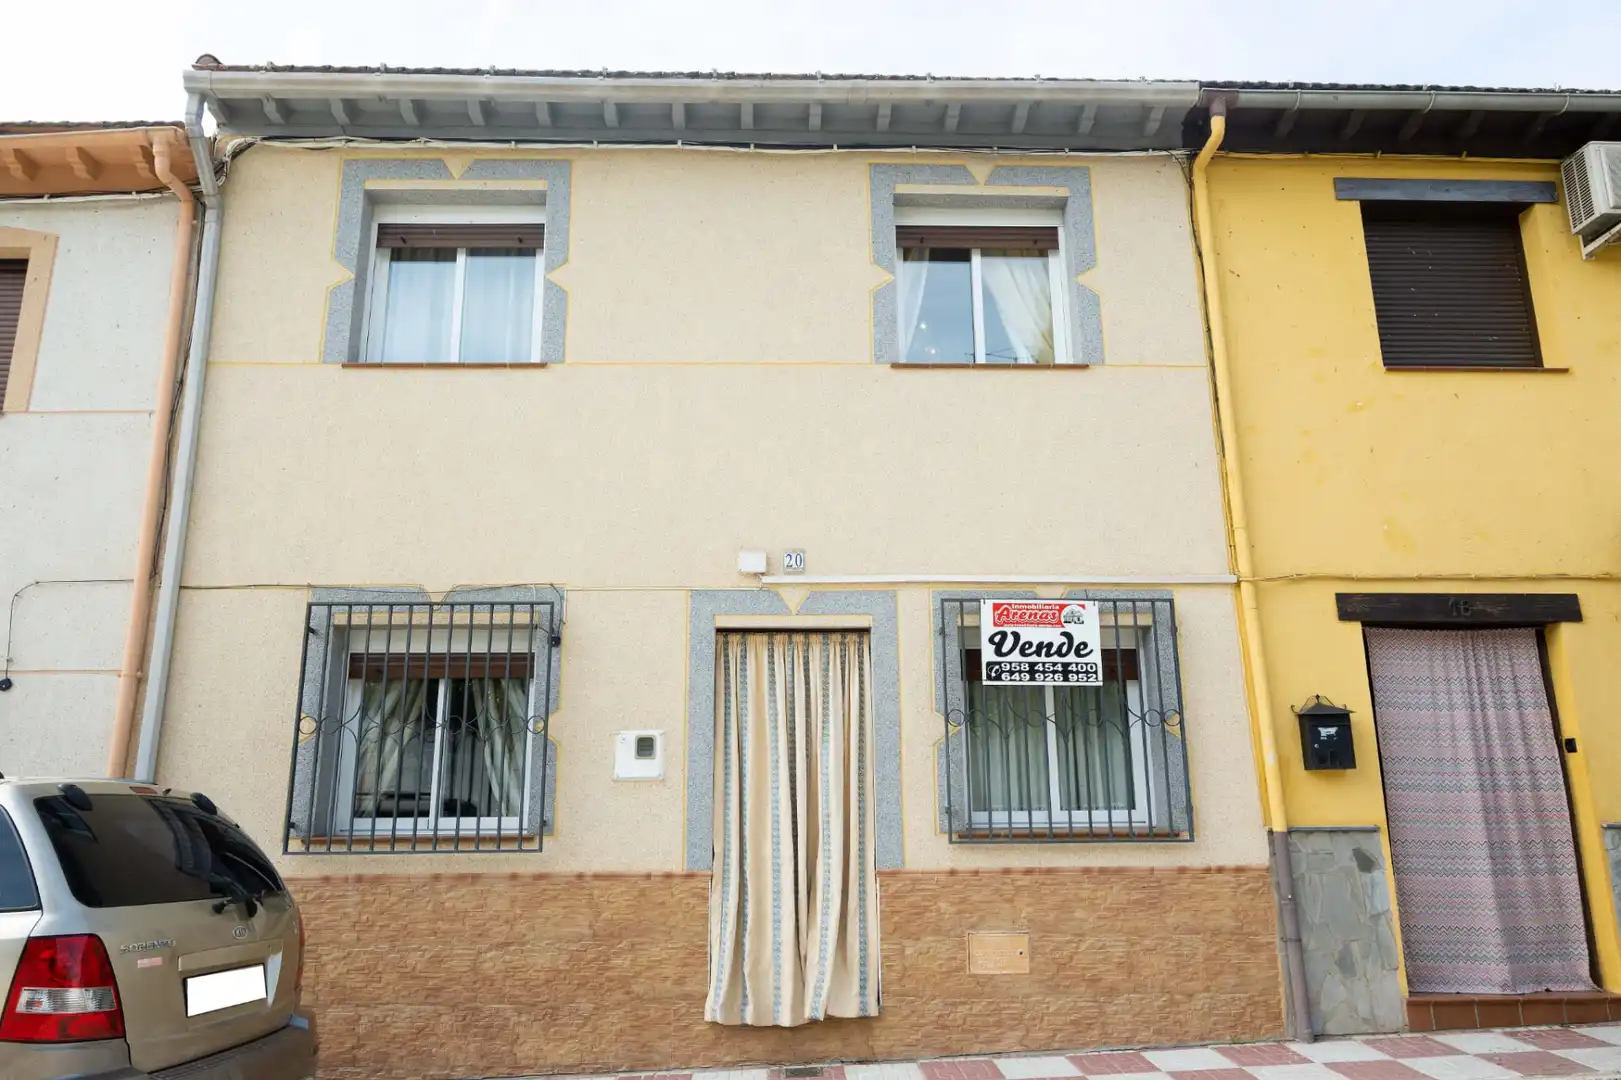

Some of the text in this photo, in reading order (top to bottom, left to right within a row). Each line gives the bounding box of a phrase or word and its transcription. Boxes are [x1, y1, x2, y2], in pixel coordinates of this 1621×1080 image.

[785, 553, 803, 568] 20
[996, 605, 1059, 624] Arenas
[988, 630, 1093, 658] Vende
[1001, 662, 1096, 672] 958 454 400
[1001, 673, 1097, 682] 649 926 952
